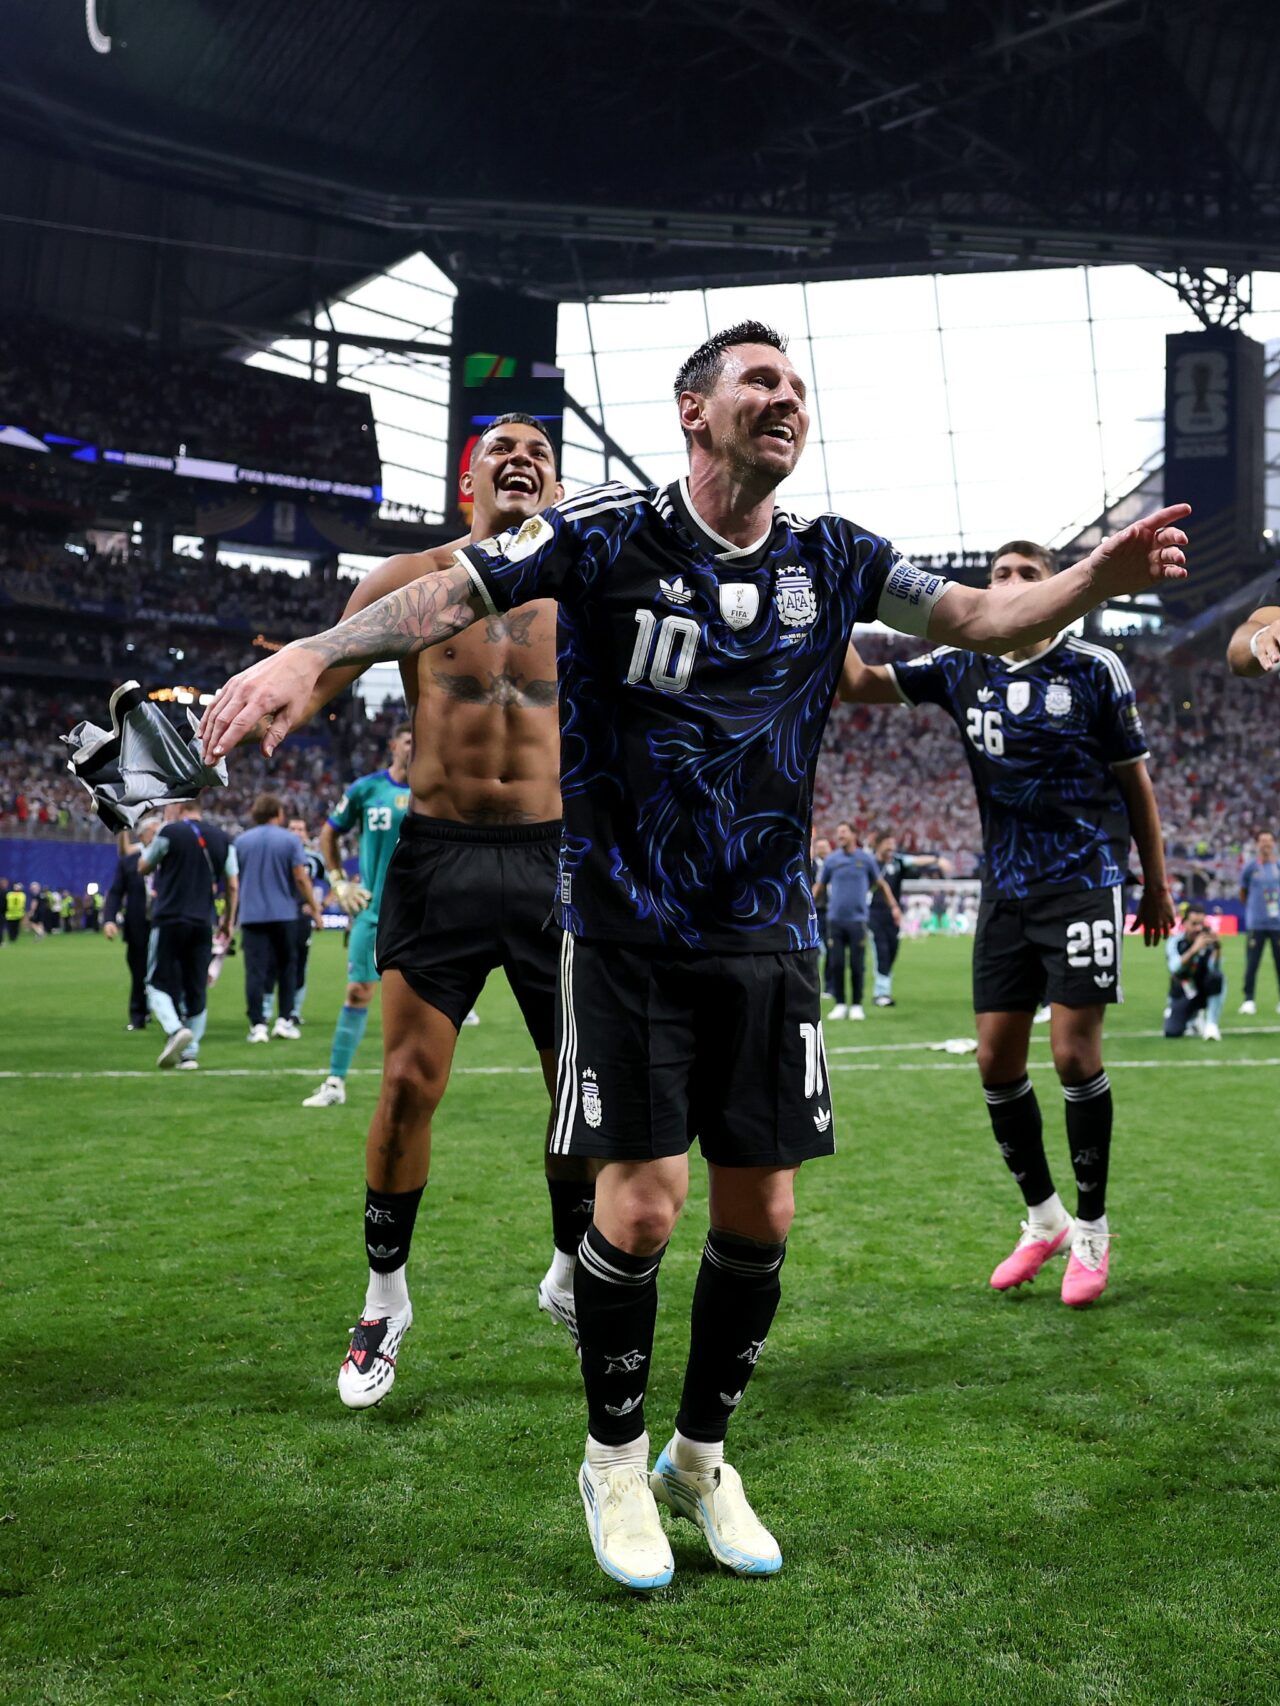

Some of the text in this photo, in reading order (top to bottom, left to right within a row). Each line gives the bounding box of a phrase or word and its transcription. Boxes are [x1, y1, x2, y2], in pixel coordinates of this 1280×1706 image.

[731, 610, 748, 618] FIFA
[627, 609, 701, 694] 10
[966, 707, 1004, 756] 26
[367, 807, 392, 831] 23
[1066, 920, 1114, 967] 26
